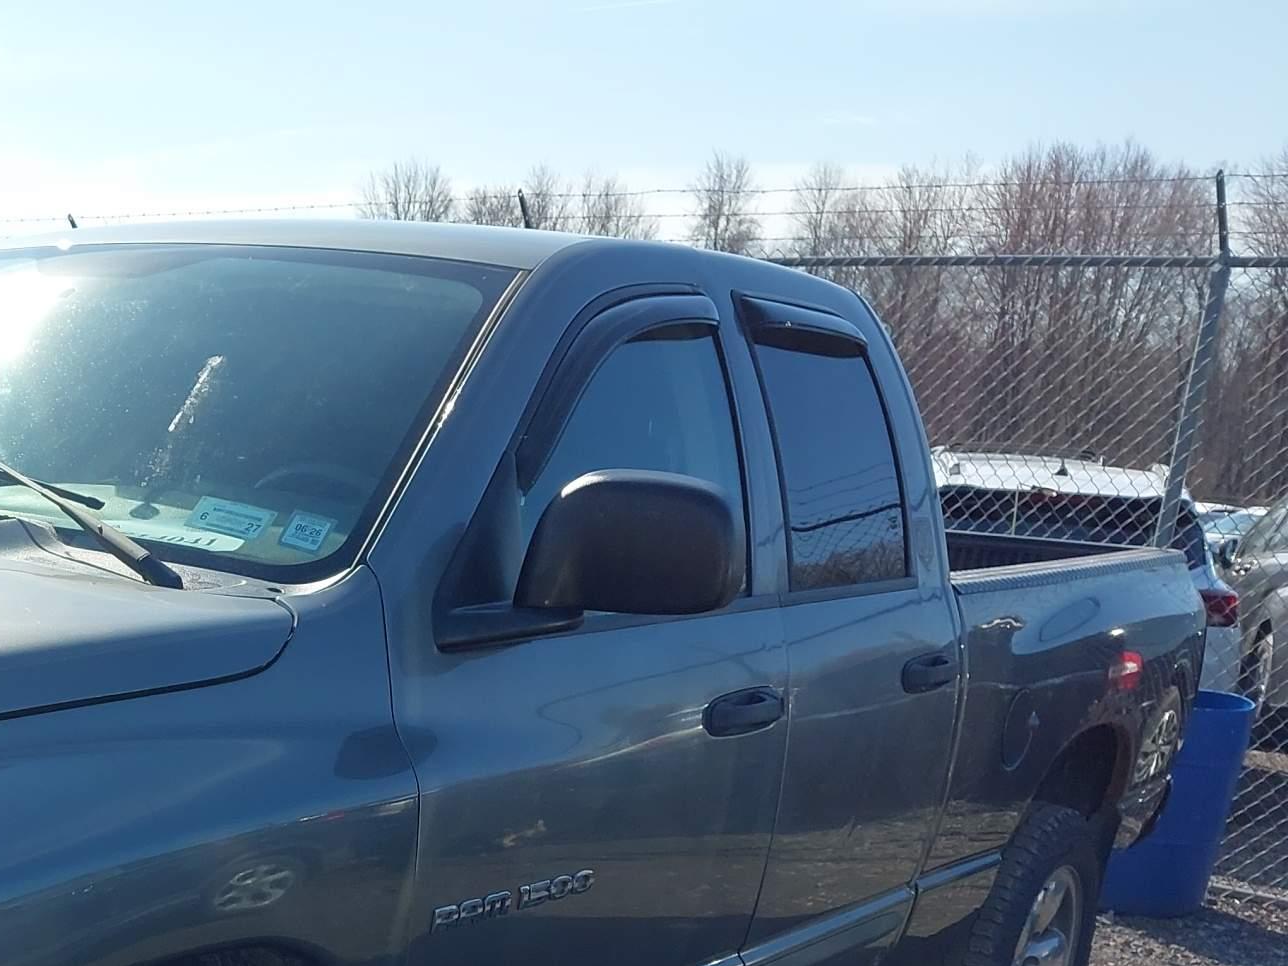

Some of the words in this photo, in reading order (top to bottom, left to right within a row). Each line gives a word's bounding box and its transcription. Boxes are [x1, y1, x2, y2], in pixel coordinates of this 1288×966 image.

[199, 511, 210, 521] 6
[244, 522, 262, 533] 27
[518, 868, 596, 910] 1500
